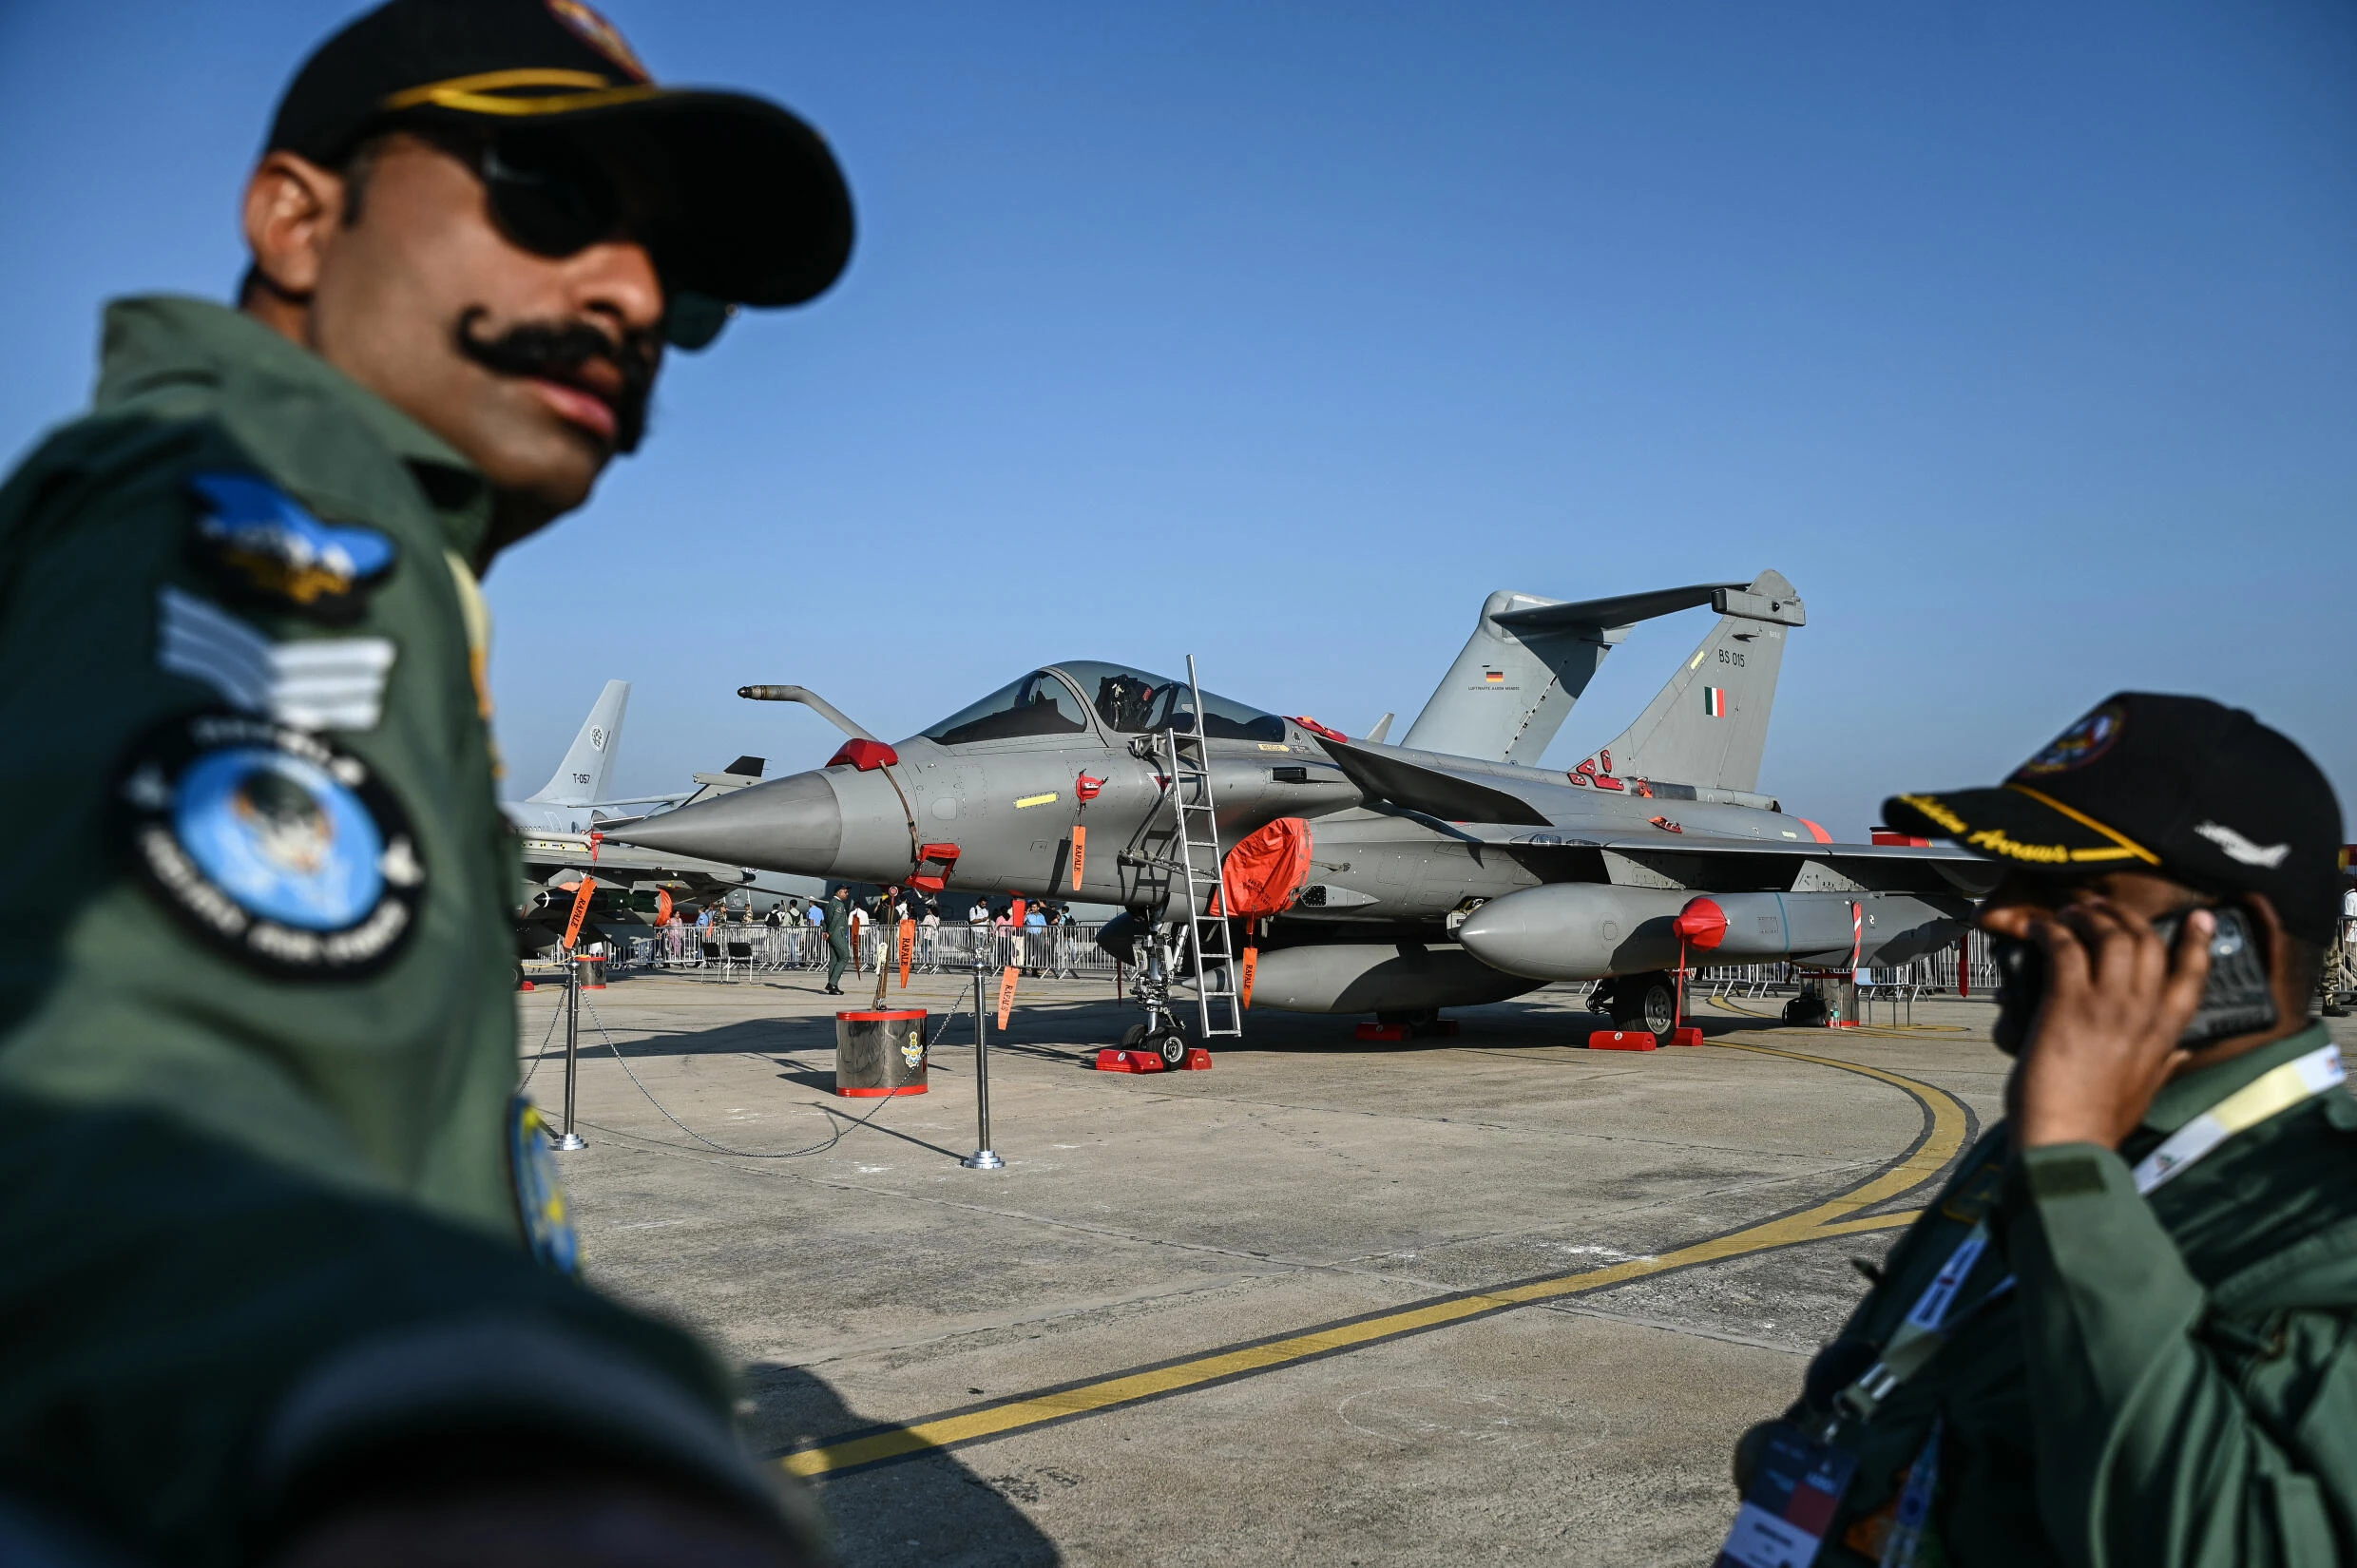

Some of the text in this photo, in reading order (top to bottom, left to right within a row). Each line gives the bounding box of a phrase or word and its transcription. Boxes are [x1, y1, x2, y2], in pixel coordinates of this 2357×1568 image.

[1718, 648, 1745, 667] BS 015
[572, 773, 590, 784] T-057
[1074, 844, 1083, 871] RAFALE
[570, 896, 586, 928] RAFALE
[901, 937, 910, 966] RAFALE
[1244, 964, 1254, 989] RAFALE
